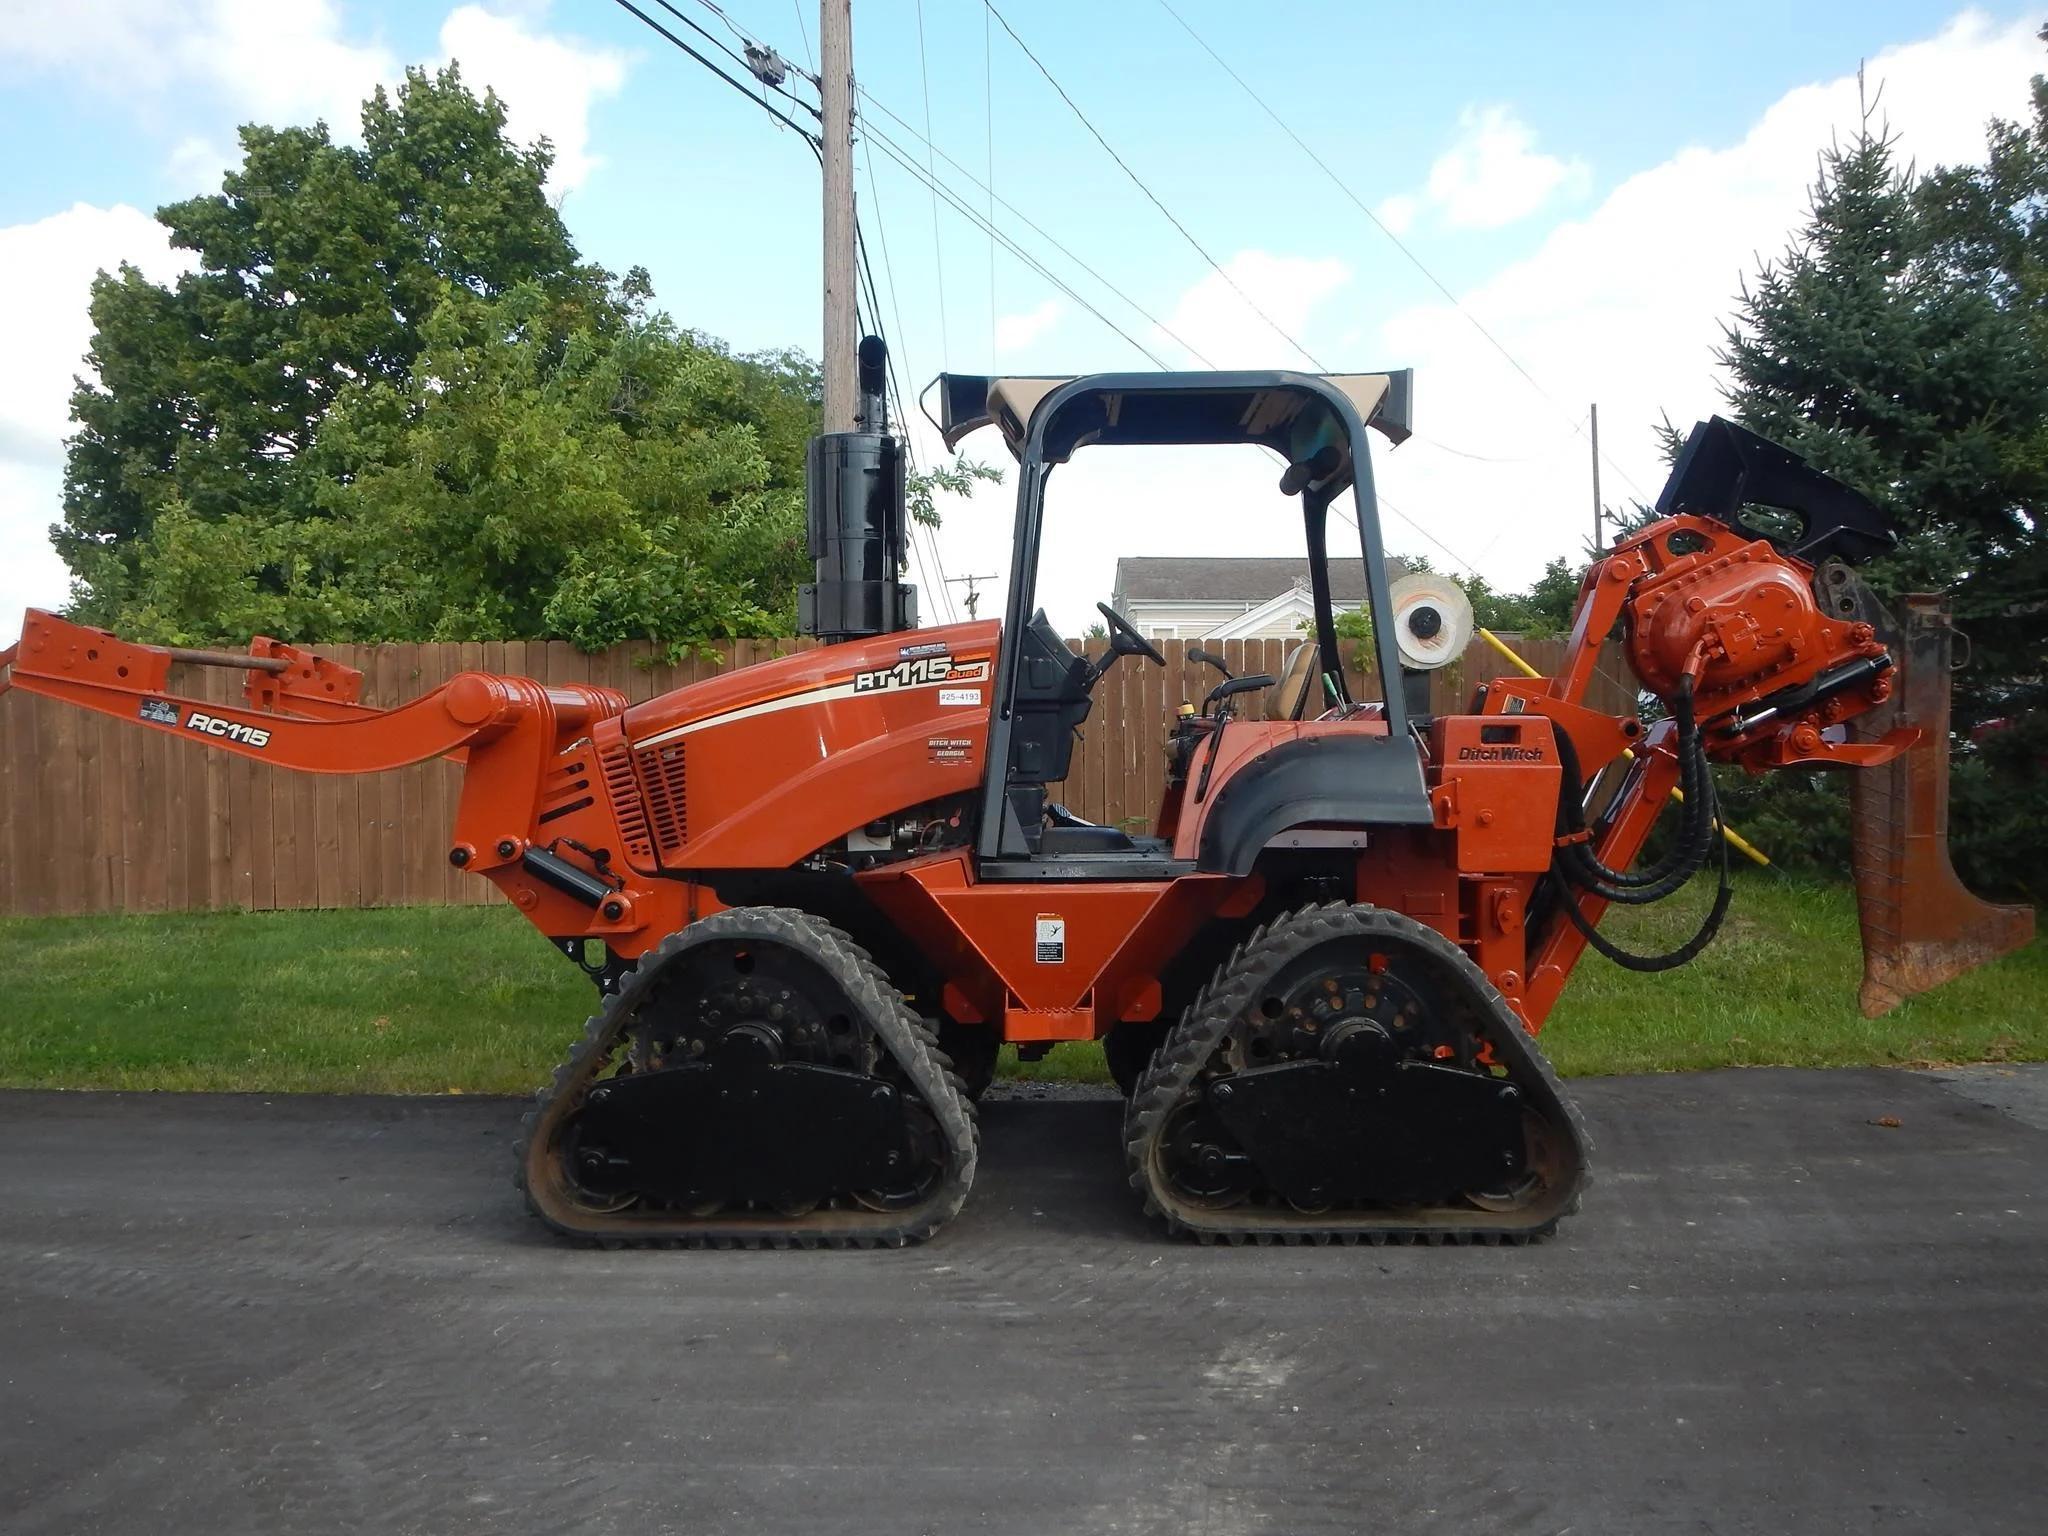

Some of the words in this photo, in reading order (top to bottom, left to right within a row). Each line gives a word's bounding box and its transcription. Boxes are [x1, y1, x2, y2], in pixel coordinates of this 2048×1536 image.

[857, 657, 952, 690] RT115
[946, 667, 982, 680] Quad
[941, 693, 980, 701] #25-4193
[188, 712, 271, 748] RC115
[1458, 747, 1499, 761] Ditch
[1501, 747, 1543, 761] Witch
